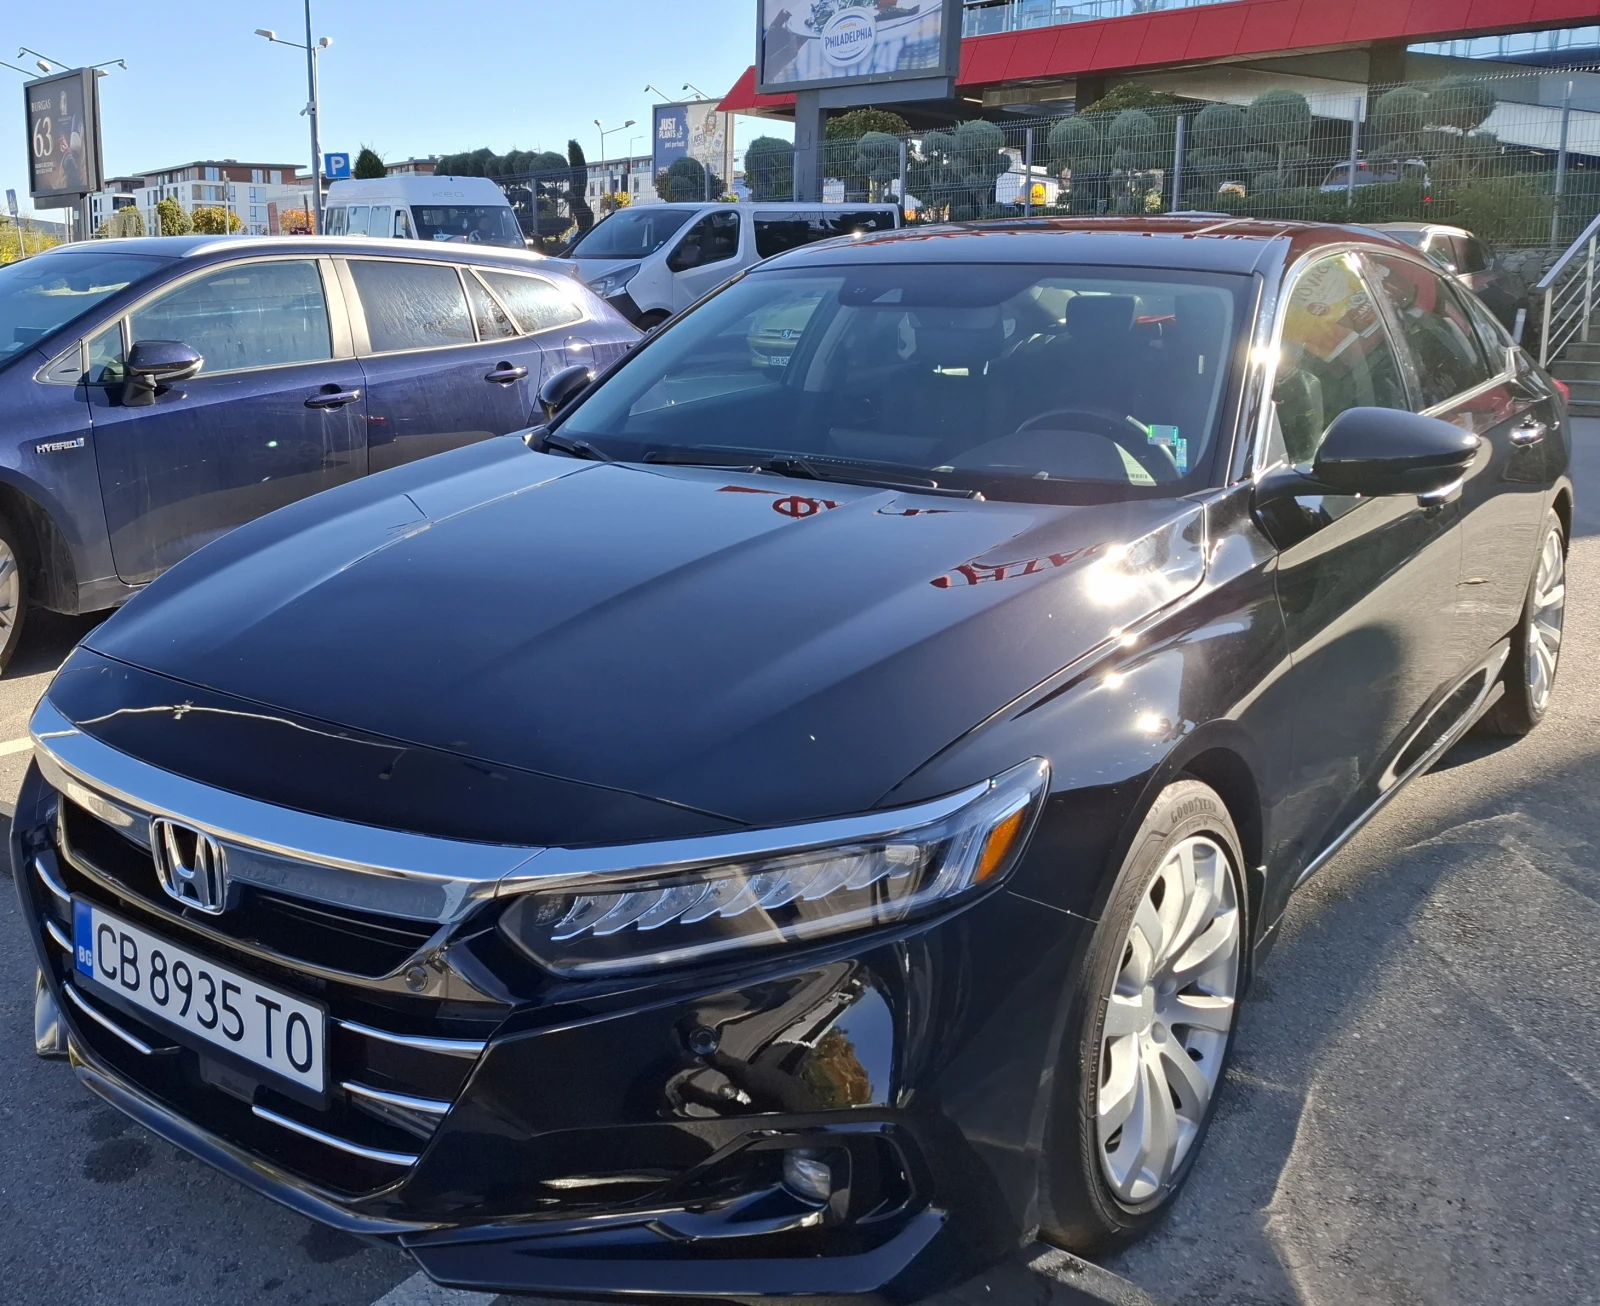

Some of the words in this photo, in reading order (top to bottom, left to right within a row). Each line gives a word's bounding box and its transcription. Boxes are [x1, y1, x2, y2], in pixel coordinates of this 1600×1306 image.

[825, 26, 873, 50] PHILADELPHIA
[31, 99, 51, 112] BURGAS
[659, 118, 676, 130] JUST
[33, 117, 53, 158] 63
[659, 130, 676, 139] PLANTS
[331, 156, 345, 175] P
[36, 441, 77, 453] HYBRID
[1171, 797, 1216, 824] GOODYEAR
[78, 945, 92, 967] BG
[97, 922, 140, 992] CB
[150, 950, 244, 1042] 8935
[255, 995, 313, 1073] TO
